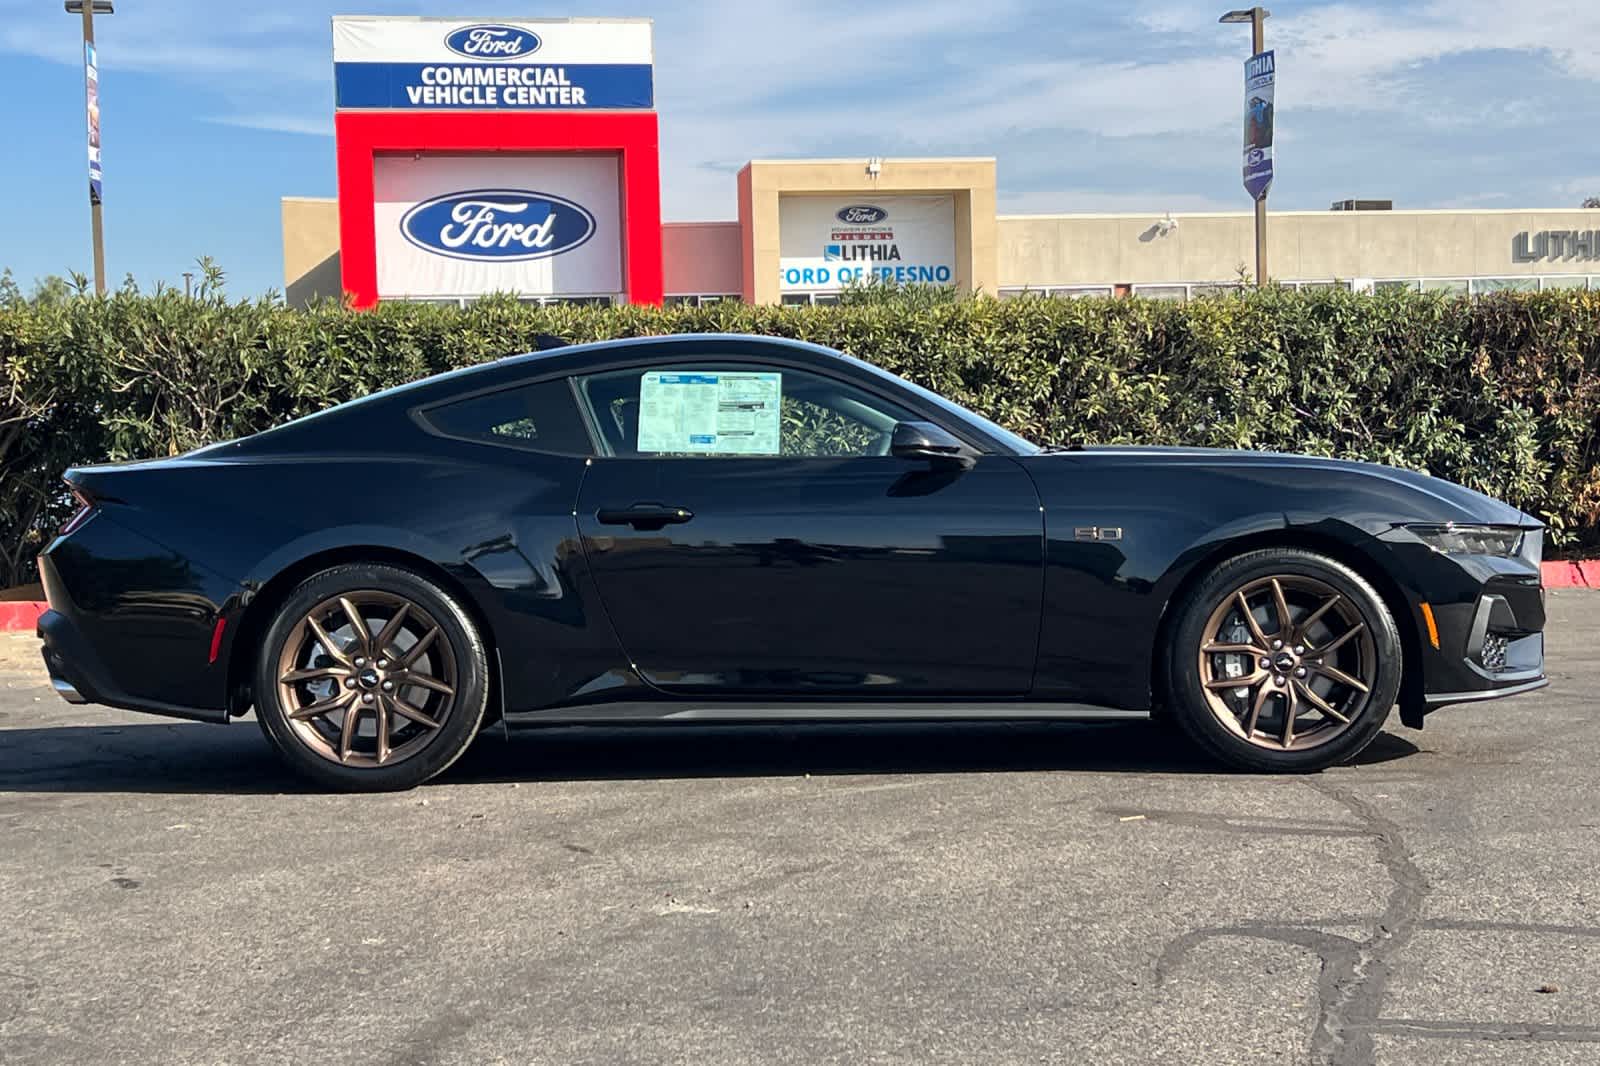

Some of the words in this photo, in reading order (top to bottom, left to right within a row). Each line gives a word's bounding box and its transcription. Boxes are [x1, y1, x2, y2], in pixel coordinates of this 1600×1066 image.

[463, 27, 522, 55] Ford
[421, 66, 570, 86] COMMERCIAL
[406, 86, 497, 105] VEHICLE
[503, 86, 587, 105] CENTER
[439, 200, 558, 248] Ford
[845, 207, 878, 222] Ford
[842, 244, 901, 261] LITHIA
